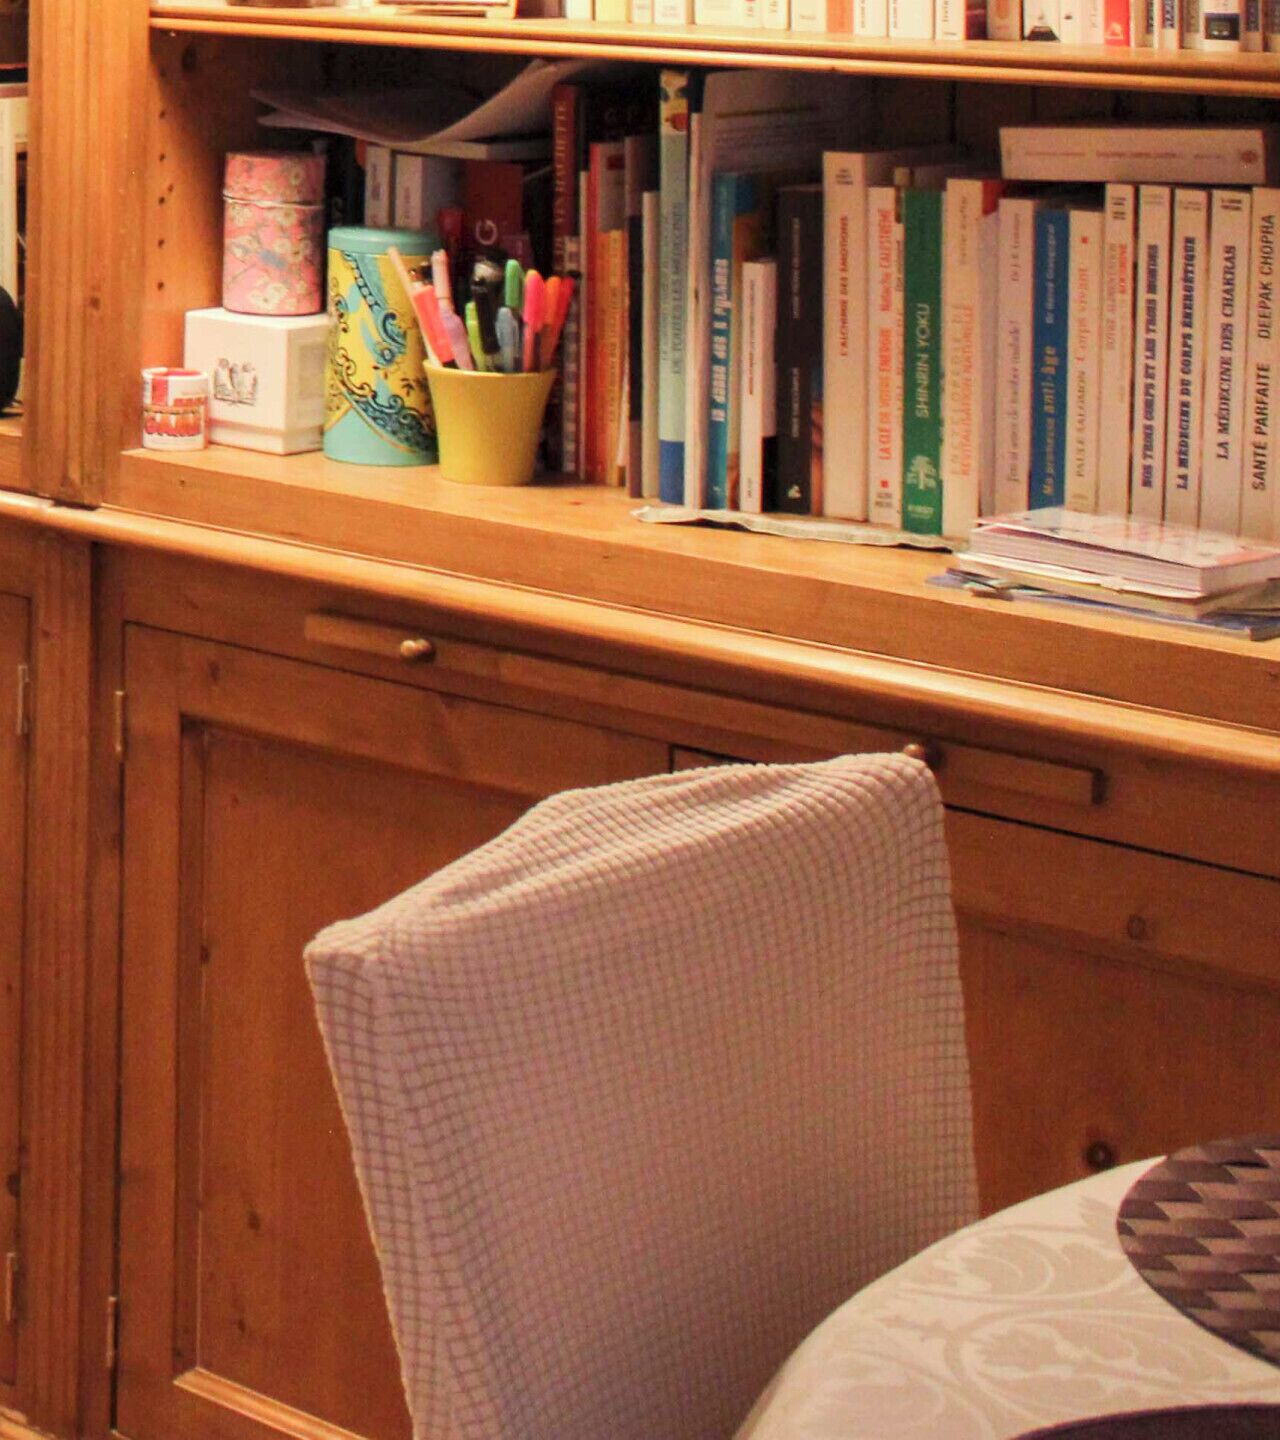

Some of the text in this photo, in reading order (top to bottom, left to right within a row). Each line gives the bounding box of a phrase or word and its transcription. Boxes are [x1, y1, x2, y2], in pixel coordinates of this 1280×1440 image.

[839, 275, 849, 296] DES
[878, 272, 893, 313] Natacha
[1144, 298, 1158, 335] TROIS
[712, 335, 727, 359] des
[915, 303, 932, 420] SHINRIN YOKU
[1143, 337, 1157, 362] LES
[1175, 236, 1196, 490] LA MÉDECINE DU CORPS ÉNERGÉTIQUE
[1214, 244, 1237, 460] LA MÉDECINE DES CHAKRAS
[1250, 214, 1275, 492] SANTÉ PARFAITE DEEPAK CHOPRA
[711, 364, 727, 405] danse
[1038, 345, 1059, 415] anti-âge
[1143, 362, 1156, 381] ET
[878, 376, 892, 408] VOTRE
[1075, 369, 1087, 434] SALOMON
[1142, 382, 1156, 422] CORPS
[877, 426, 892, 445] CLÉ
[878, 411, 892, 425] DE
[878, 447, 892, 460] LA
[1140, 423, 1155, 462] TROIS
[1140, 463, 1154, 489] NOS
